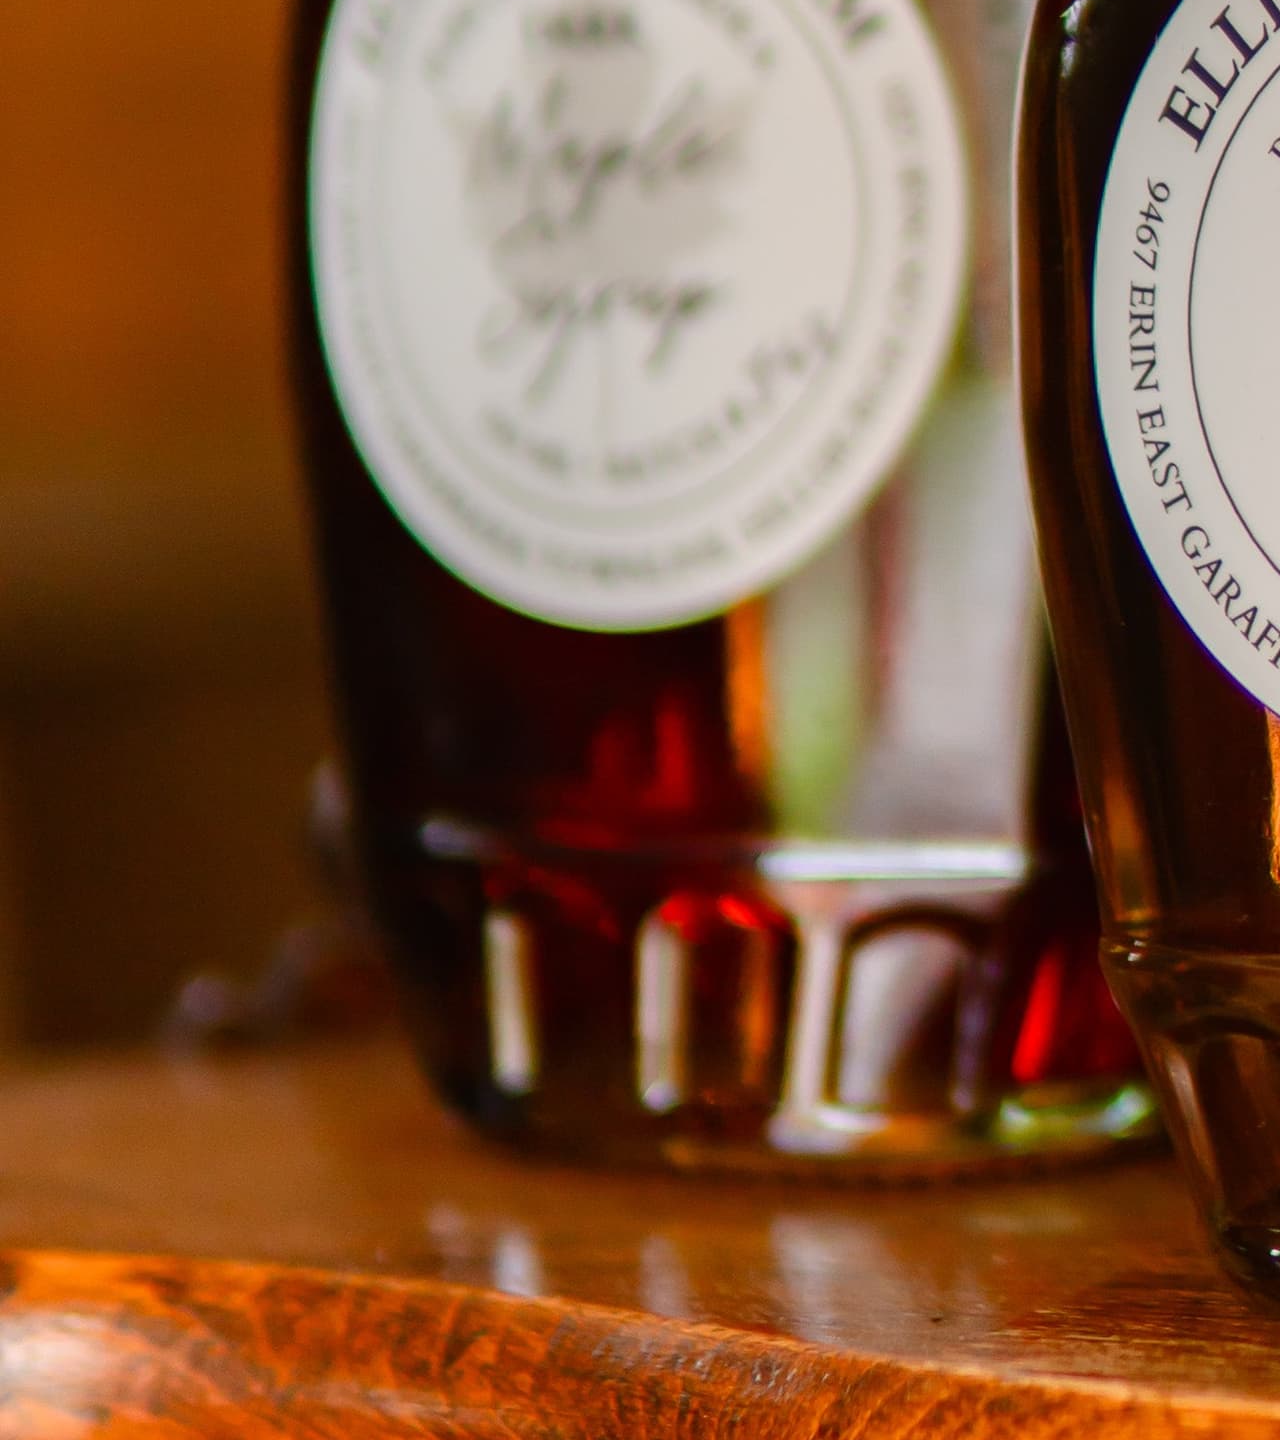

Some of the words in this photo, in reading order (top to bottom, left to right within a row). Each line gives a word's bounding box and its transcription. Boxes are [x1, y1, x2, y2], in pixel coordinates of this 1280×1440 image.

[1132, 178, 1172, 272] 9467
[1128, 282, 1160, 392] ERIN
[1136, 404, 1194, 514] EAST
